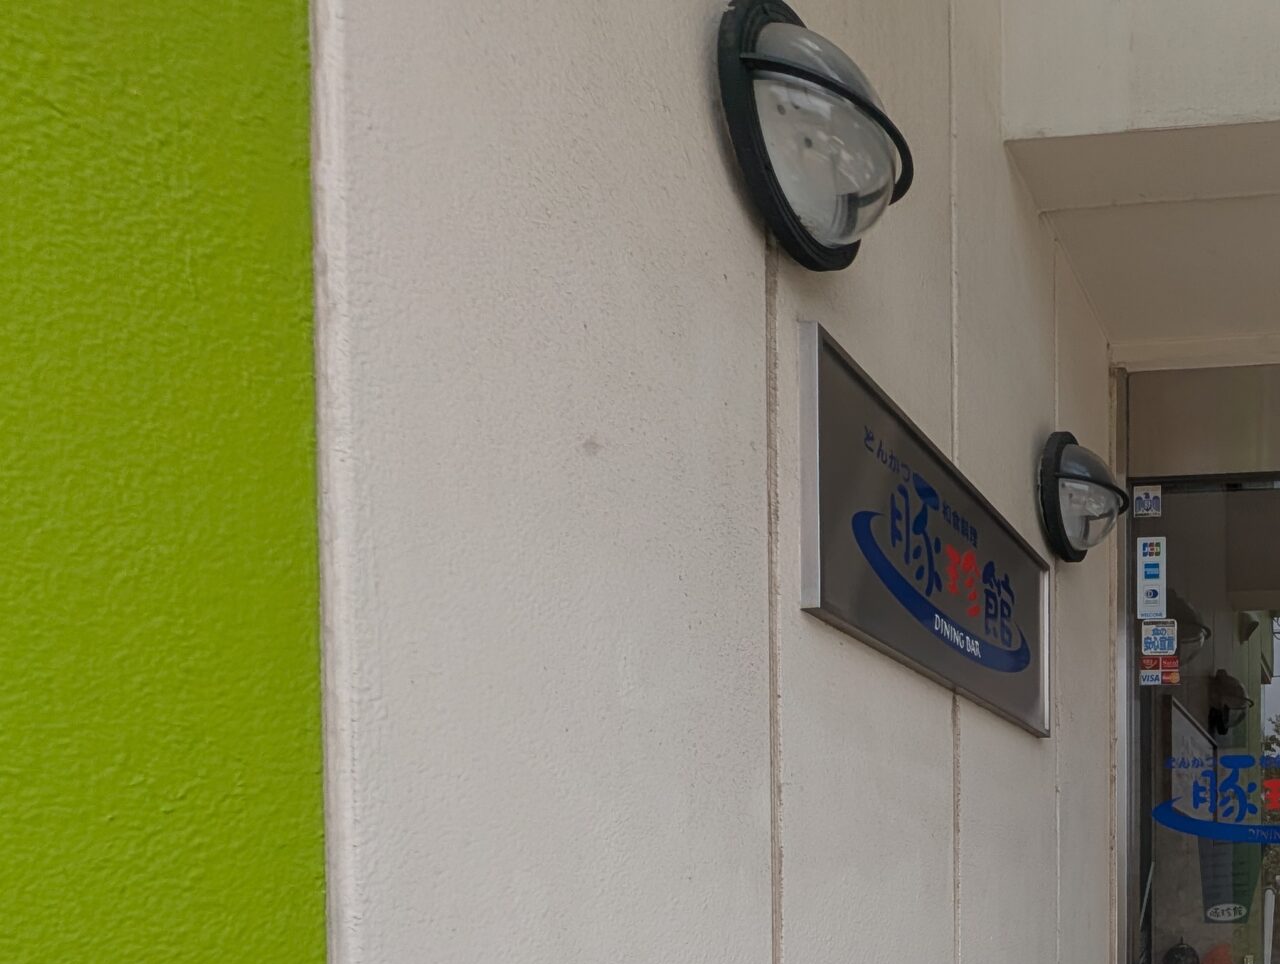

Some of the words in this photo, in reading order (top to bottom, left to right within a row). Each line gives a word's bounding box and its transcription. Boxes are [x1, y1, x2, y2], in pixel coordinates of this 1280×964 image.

[864, 426, 911, 483] とんかつ
[890, 473, 1016, 649] 豚珍館
[934, 613, 965, 649] DINING
[965, 636, 982, 659] BAR
[1141, 674, 1160, 682] VISA
